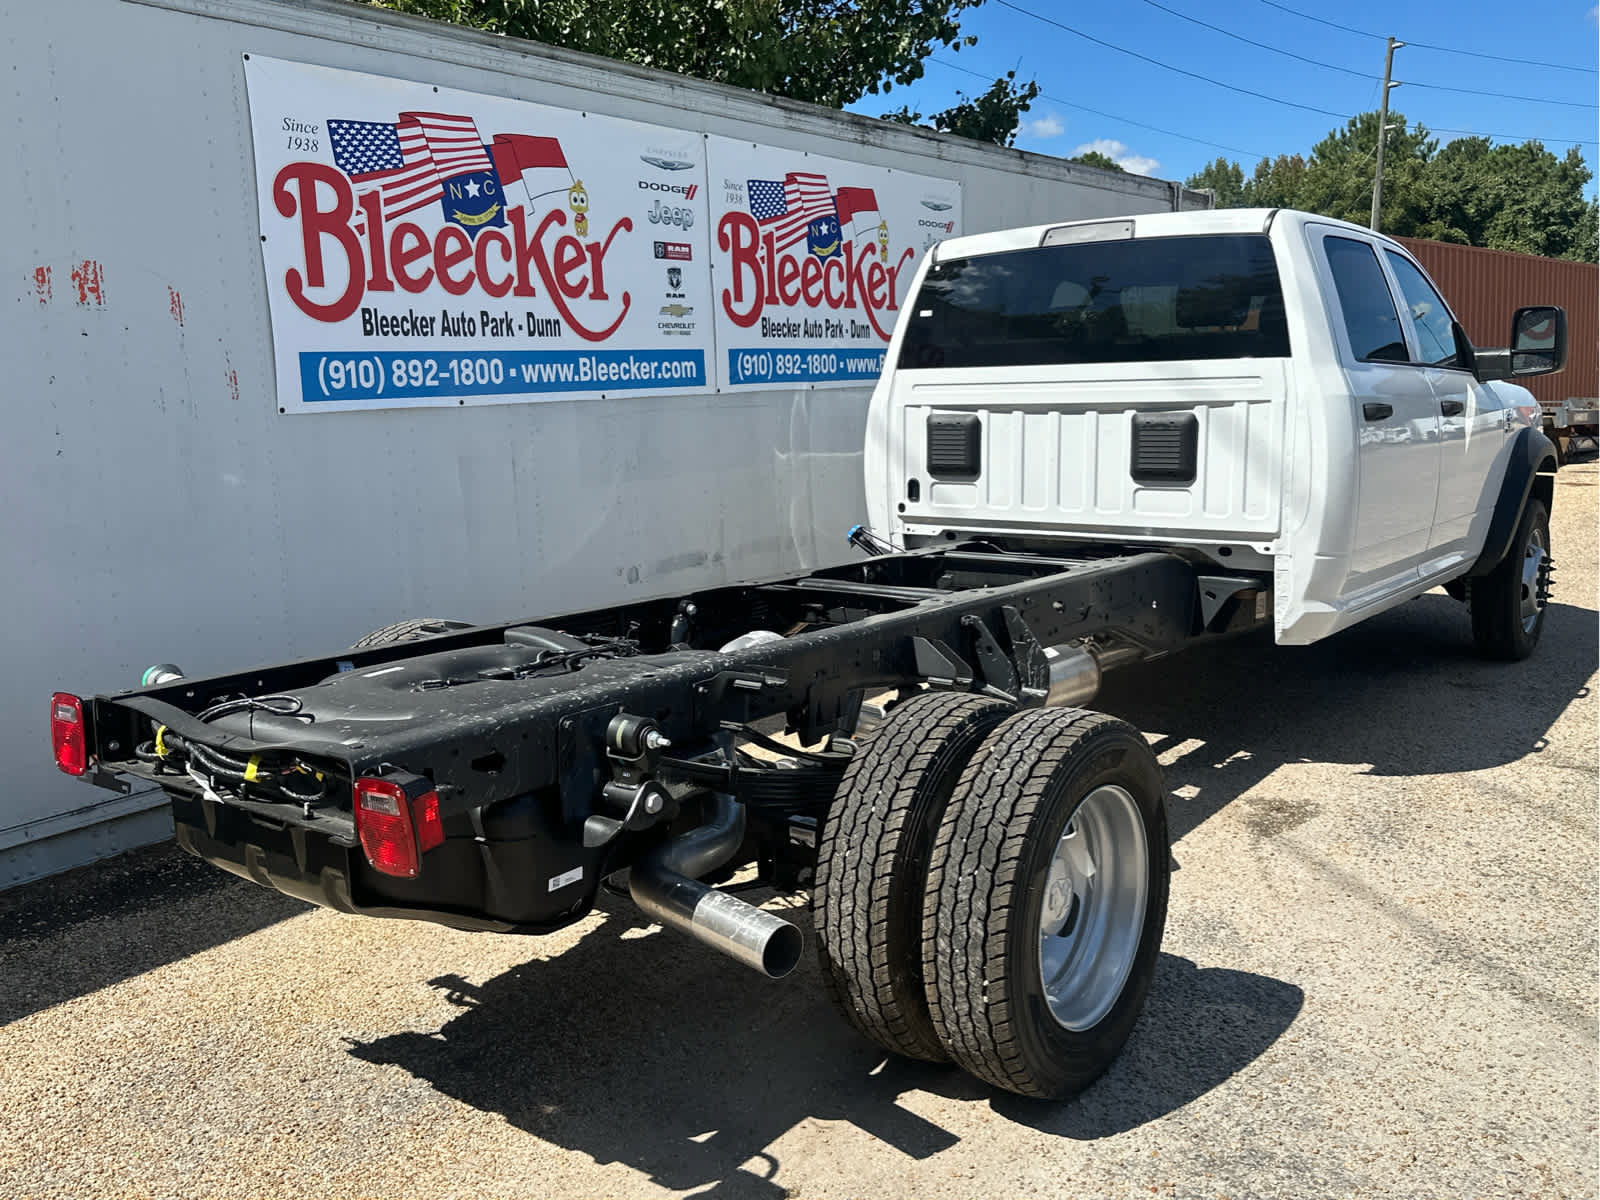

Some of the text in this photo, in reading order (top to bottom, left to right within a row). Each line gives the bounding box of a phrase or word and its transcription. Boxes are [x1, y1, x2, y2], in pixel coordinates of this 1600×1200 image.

[282, 117, 319, 135] Since
[287, 136, 319, 153] 1938
[449, 180, 495, 200] N C
[638, 181, 690, 195] DODGE
[647, 200, 694, 231] Jeep
[273, 162, 633, 342] Bleecker
[718, 211, 914, 342] Bleecker
[361, 307, 561, 337] Bleecker Auto Park Dunn
[761, 316, 870, 339] Bleecker Auto Park Dunn
[318, 355, 697, 396] (910) 892-1800 www.Bleecker.com
[737, 352, 773, 380] (910)
[776, 354, 837, 375] 892-1800
